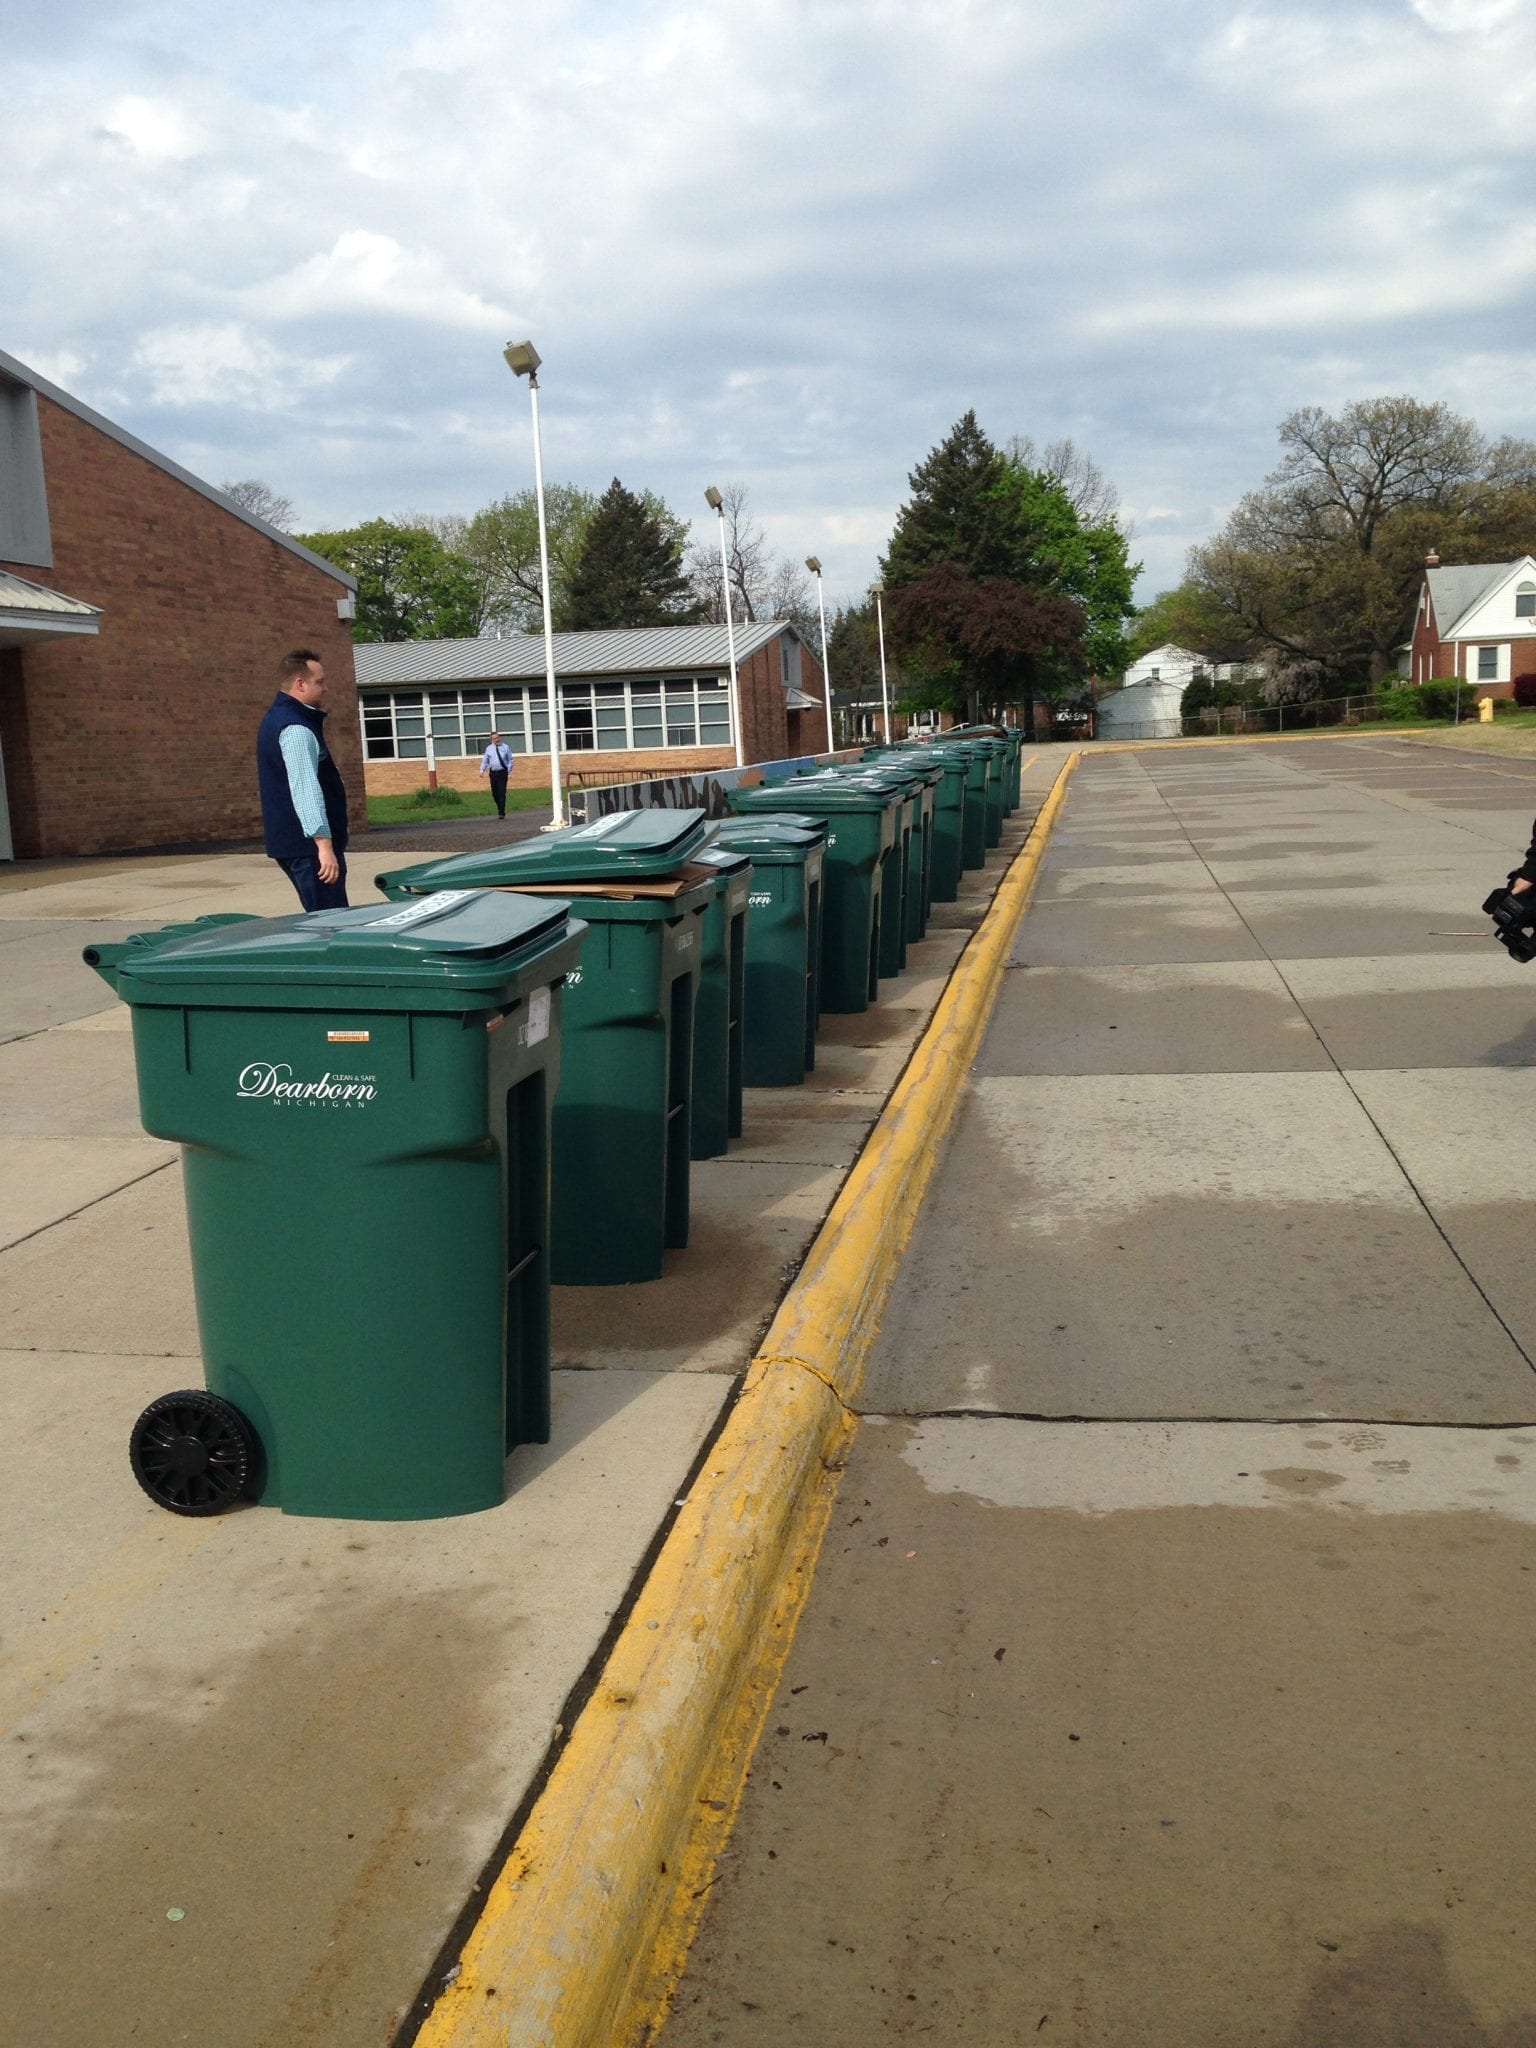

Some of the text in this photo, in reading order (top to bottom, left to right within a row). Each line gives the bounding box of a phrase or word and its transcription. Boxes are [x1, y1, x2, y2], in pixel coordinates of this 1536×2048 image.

[236, 1062, 378, 1100] Dearborn
[361, 1074, 377, 1082] SAFE
[273, 1099, 365, 1109] MICHIGAN
